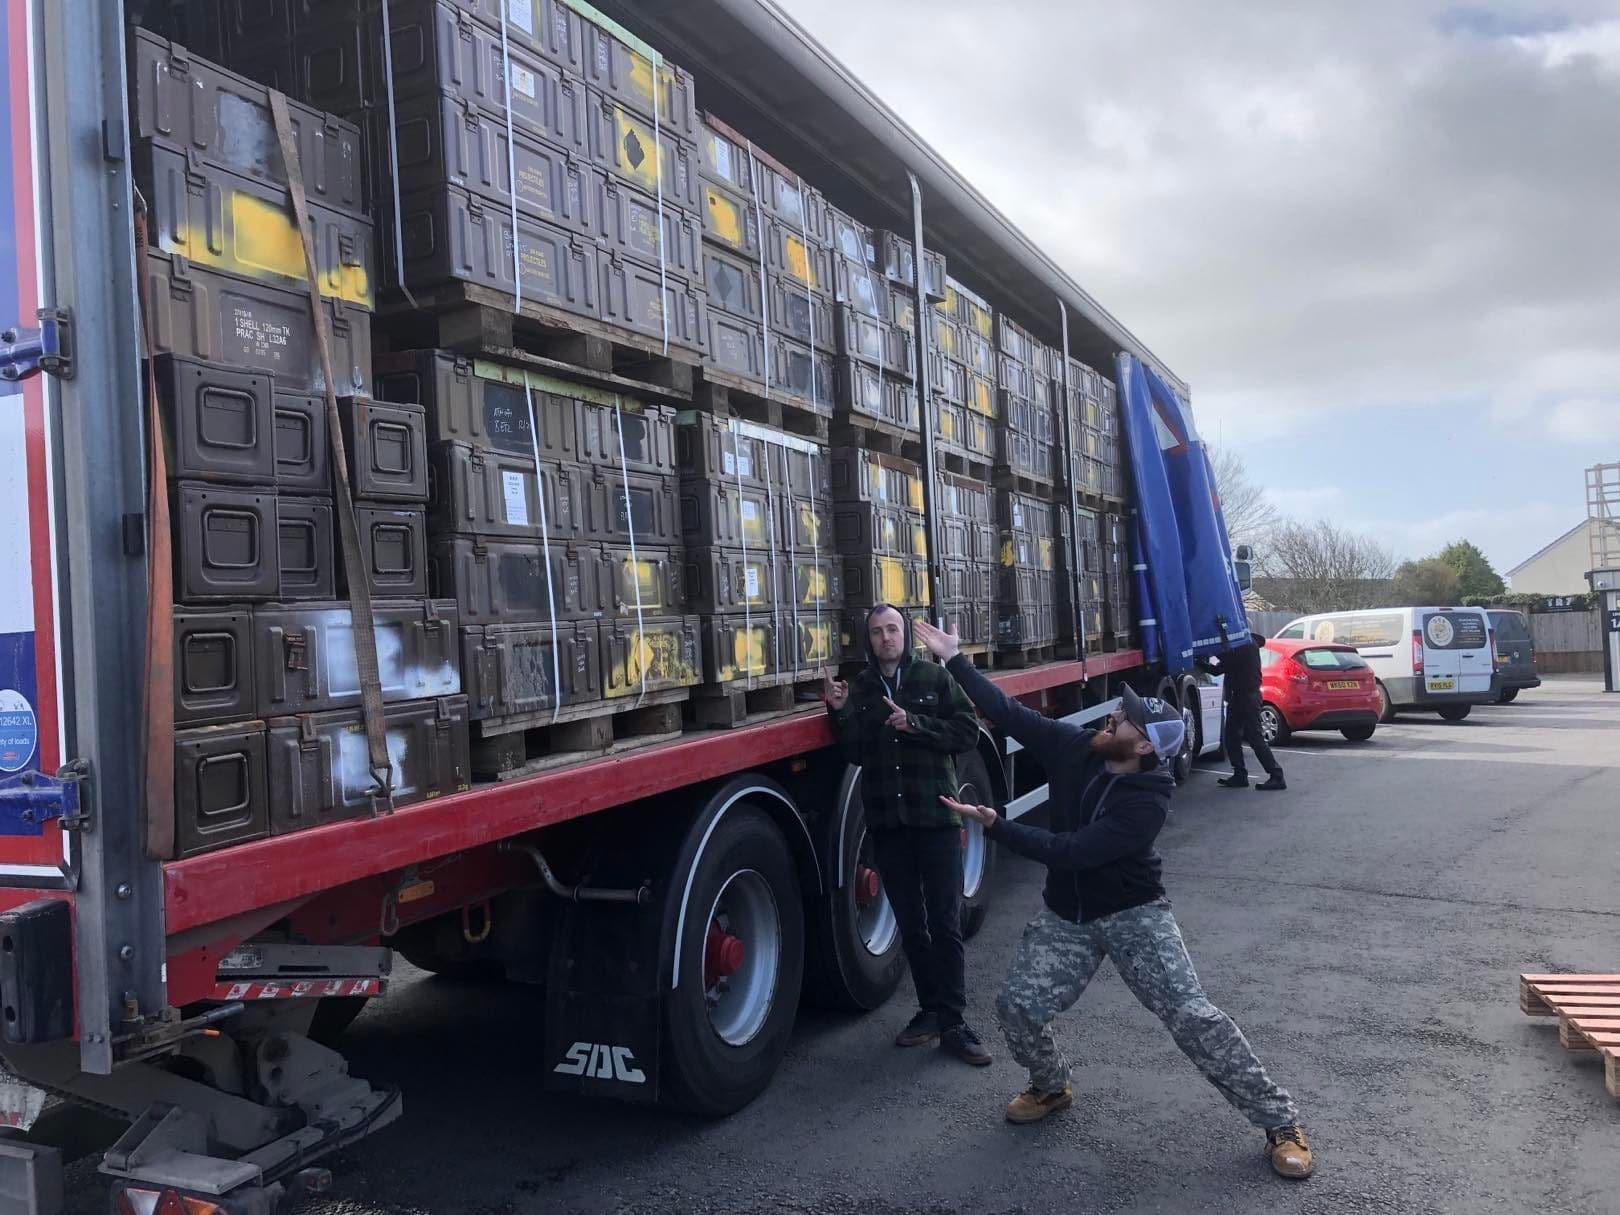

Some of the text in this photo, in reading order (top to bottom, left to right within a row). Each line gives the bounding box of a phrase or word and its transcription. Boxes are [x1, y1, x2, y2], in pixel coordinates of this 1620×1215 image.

[240, 318, 260, 331] SHELL
[236, 327, 254, 340] PRAC
[256, 331, 266, 342] SH
[553, 1042, 646, 1083] SDC
